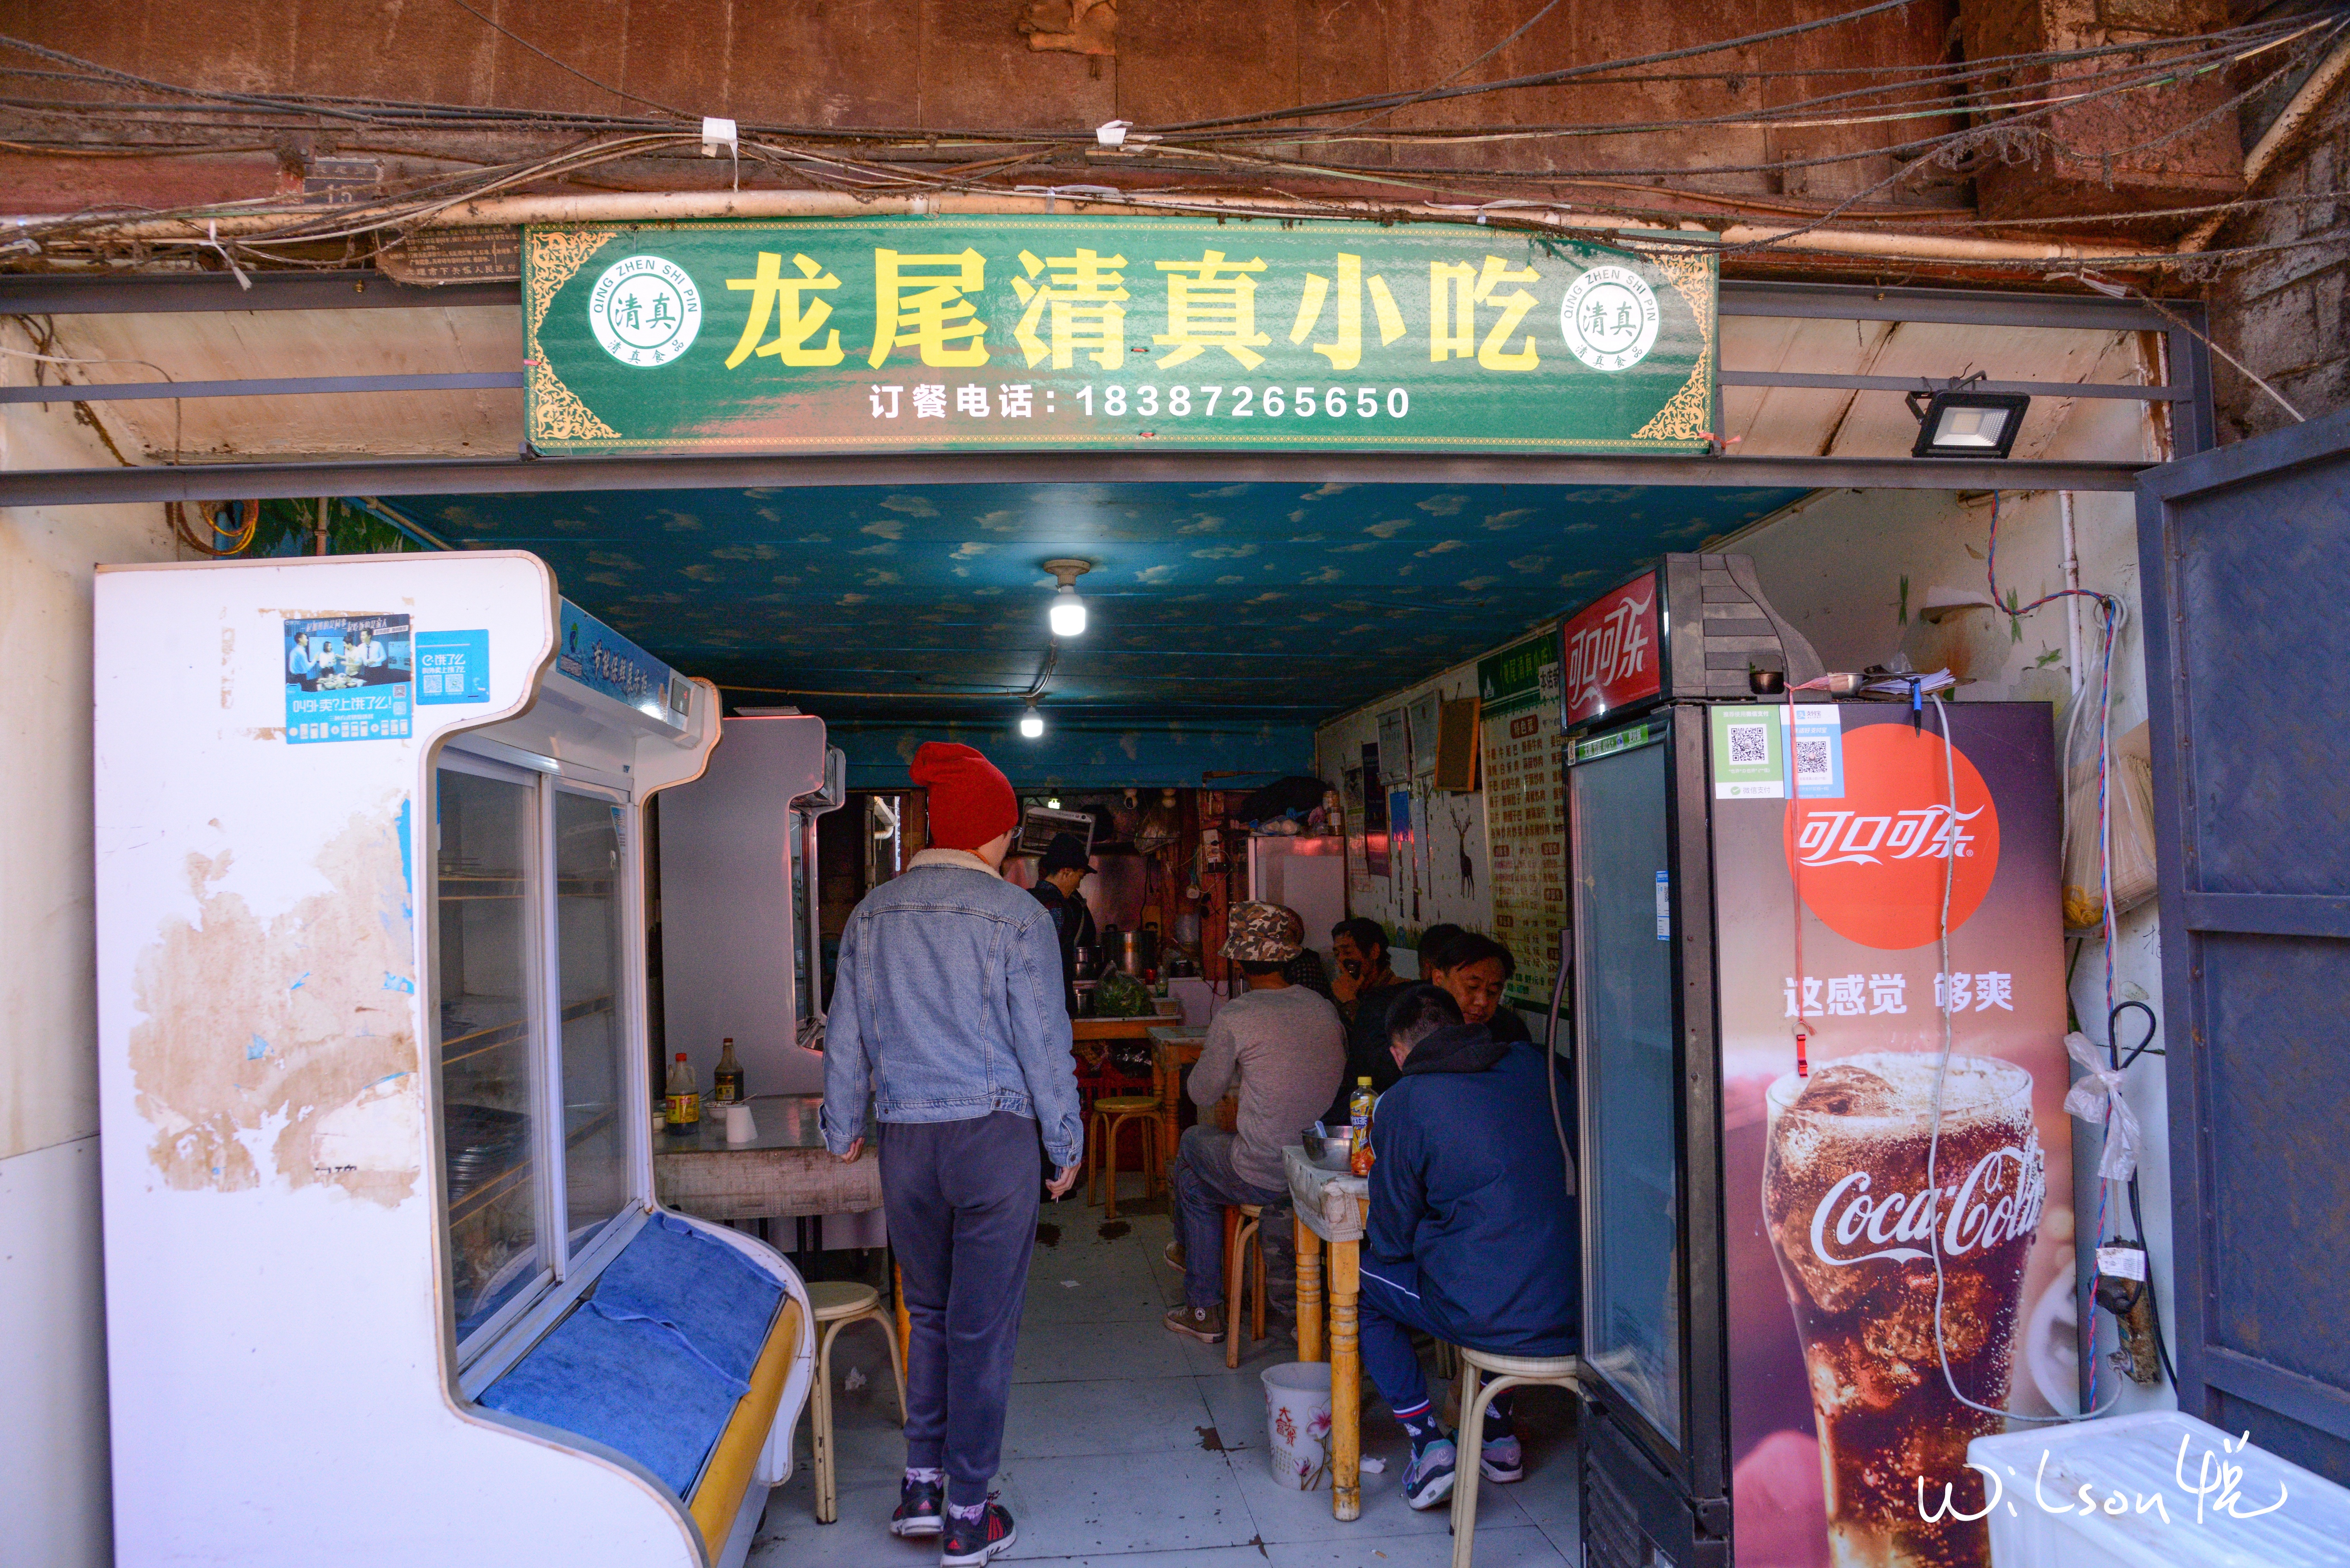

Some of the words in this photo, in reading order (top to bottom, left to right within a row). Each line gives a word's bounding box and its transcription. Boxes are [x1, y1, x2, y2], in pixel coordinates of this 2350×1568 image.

[406, 264, 515, 275] 大理市下关镇人民政府
[594, 278, 614, 313] QING
[615, 259, 656, 277] ZHEN
[662, 264, 685, 286] SHI
[684, 287, 698, 313] PIN
[615, 292, 675, 331] 清真
[725, 247, 1541, 371] 龙尾清真小吃
[1563, 285, 1583, 318] QING
[1586, 271, 1621, 284] ZHEN
[1626, 275, 1645, 295] SHI
[1644, 296, 1656, 322] PIN
[1582, 302, 1637, 336] 清真
[607, 339, 685, 365] 清真食品
[1575, 344, 1643, 368] 清真食品
[435, 654, 465, 665] 饿了么
[1569, 586, 1654, 710] 可口可乐
[1799, 804, 1985, 866] 可口可乐
[1784, 974, 1907, 1017] 这感觉
[1934, 971, 2014, 1012] 够爽
